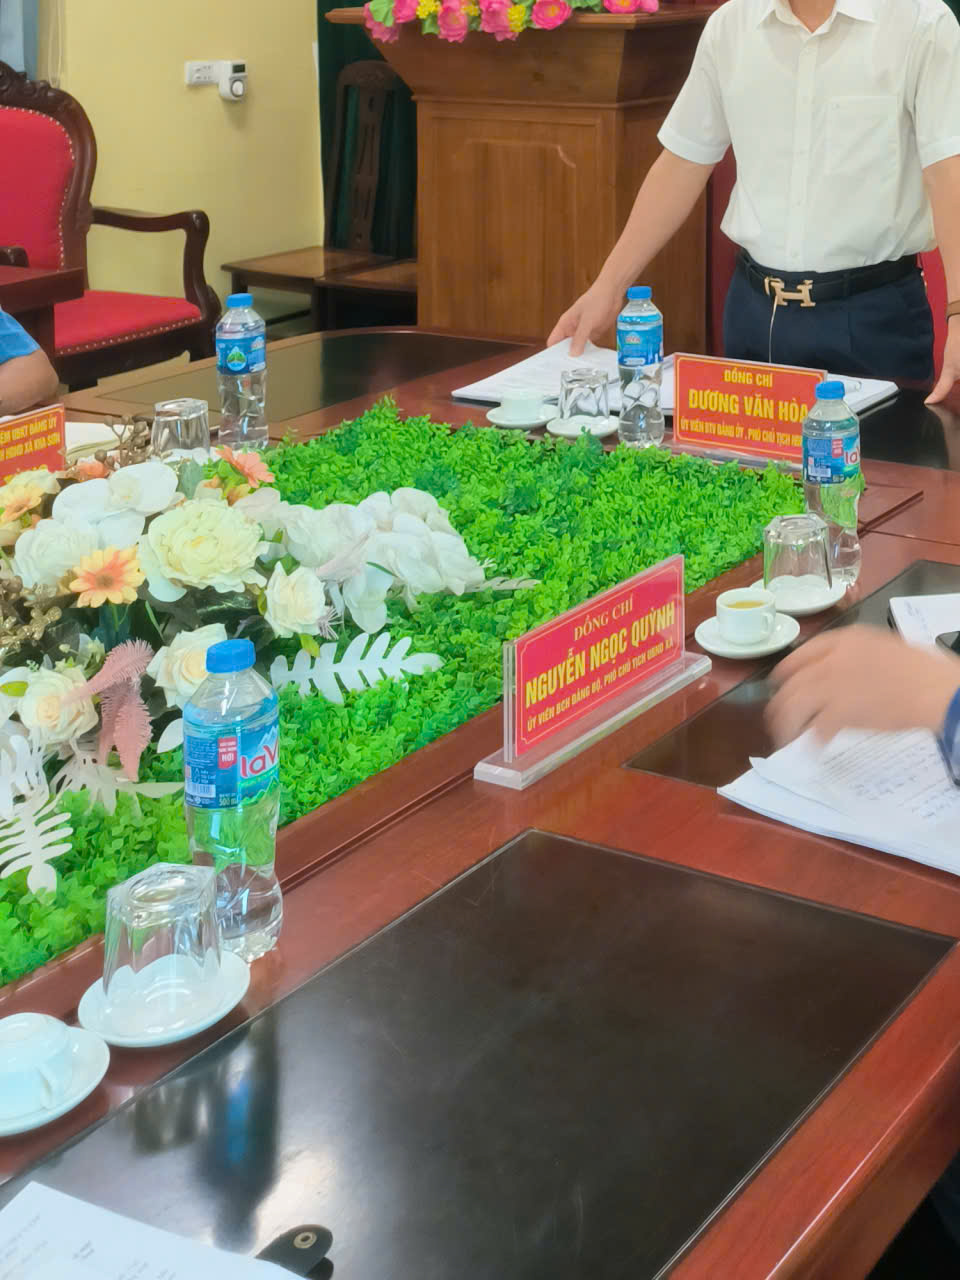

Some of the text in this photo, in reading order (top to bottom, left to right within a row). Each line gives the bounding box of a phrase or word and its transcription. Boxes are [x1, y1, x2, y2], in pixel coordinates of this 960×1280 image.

[756, 373, 773, 388] CHÍ
[688, 389, 809, 423] DƯƠNG VĂN HÒA
[612, 593, 633, 620] CHÍ
[525, 600, 675, 708] NGUYỄN NGỌC QUỲNH
